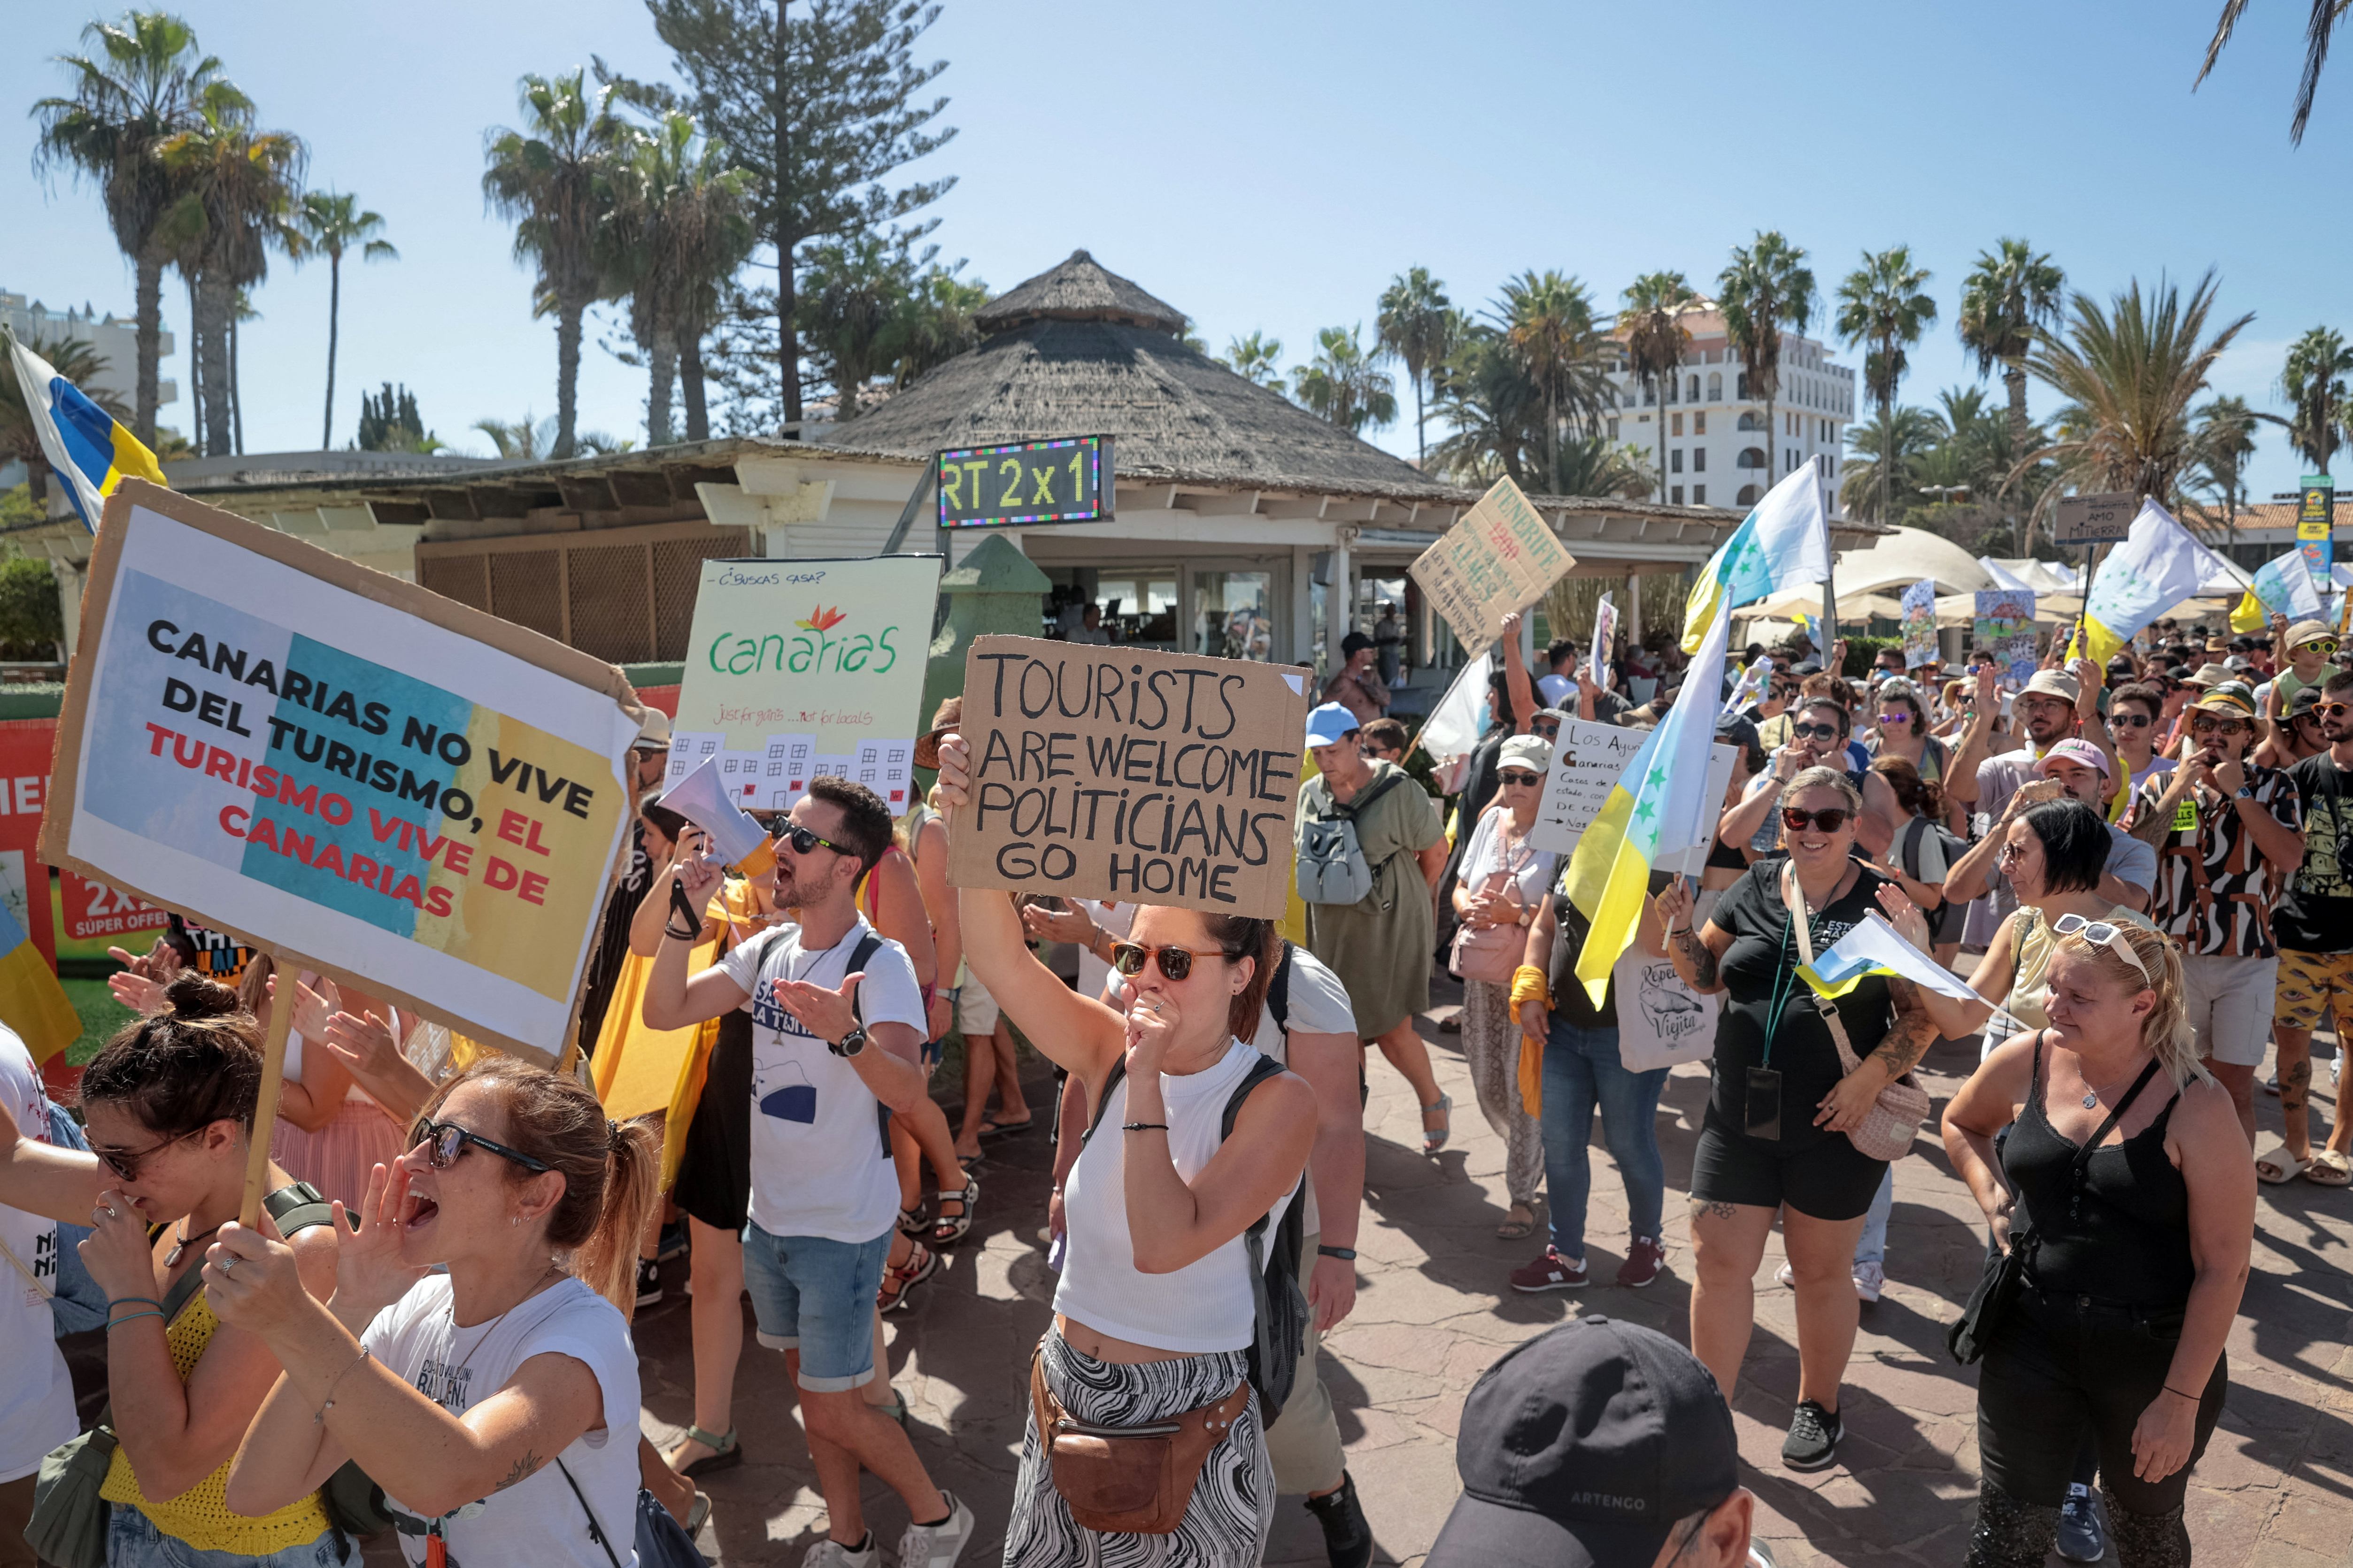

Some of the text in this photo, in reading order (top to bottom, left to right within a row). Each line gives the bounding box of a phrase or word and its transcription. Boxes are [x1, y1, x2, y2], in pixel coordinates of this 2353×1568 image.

[999, 458, 1022, 507] 2
[1068, 452, 1082, 502] 1
[2088, 512, 2114, 521] AMO
[1487, 522, 1520, 561] 1200
[786, 571, 826, 584] CASA?
[1419, 559, 1430, 574] ES
[147, 619, 594, 820] CANARIAS NO VIVE
[820, 709, 836, 726] for
[162, 677, 552, 857] DEL TURISMO, EL
[977, 729, 1297, 802] ARE WELCOME
[146, 722, 354, 826] TURISMO
[368, 807, 473, 877] VIVE
[483, 856, 550, 907] DE
[1557, 801, 1575, 811] DE
[218, 805, 456, 918] CANARIAS
[996, 842, 1239, 904] GO HOME
[76, 916, 123, 936] SÚPER
[772, 1010, 813, 1035] TEJI
[1653, 1014, 1696, 1041] Viejita
[473, 1138, 499, 1151] HAWKERS
[422, 1359, 445, 1376] CUAO
[417, 1372, 468, 1409] BALENA
[1571, 1491, 1645, 1511] ARTENGO
